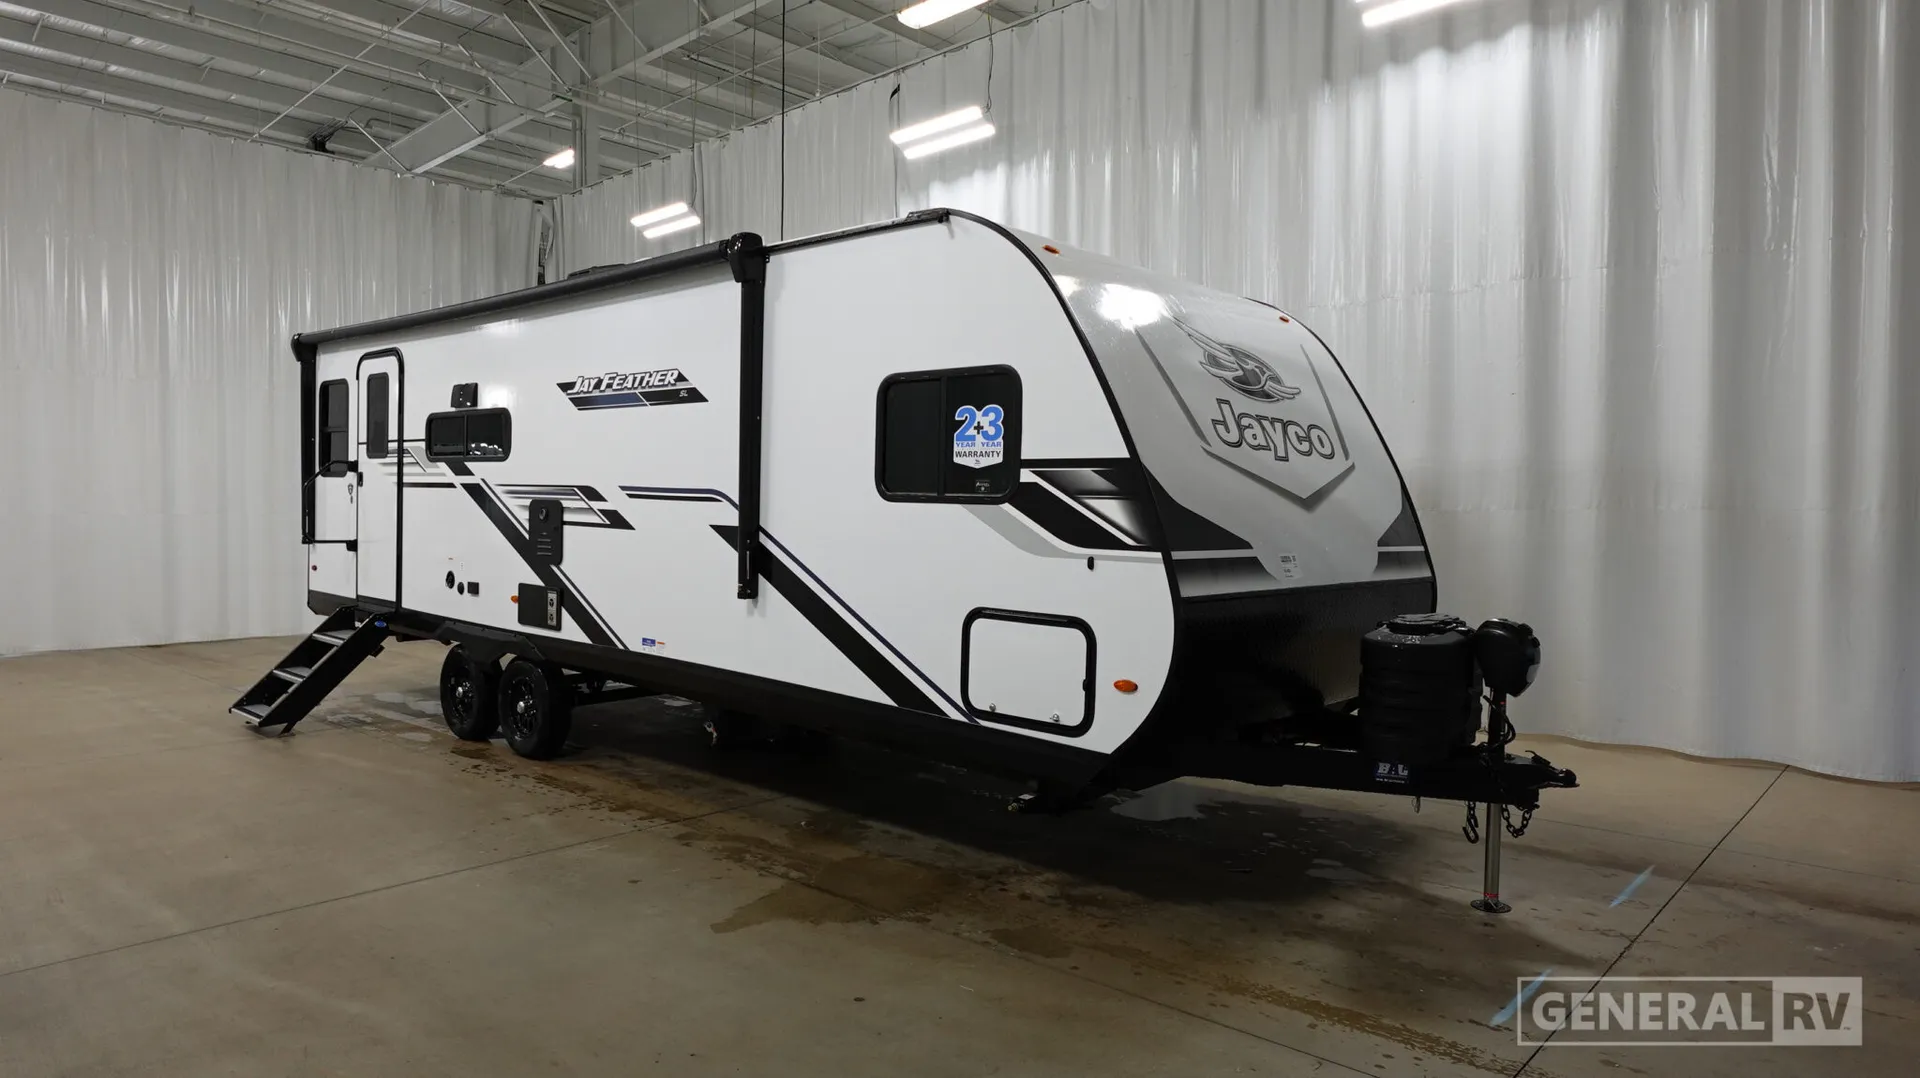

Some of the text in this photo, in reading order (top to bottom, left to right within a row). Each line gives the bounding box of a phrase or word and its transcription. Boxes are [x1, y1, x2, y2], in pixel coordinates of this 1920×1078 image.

[566, 369, 679, 395] JAY FEATHER
[1211, 398, 1335, 462] Jayco
